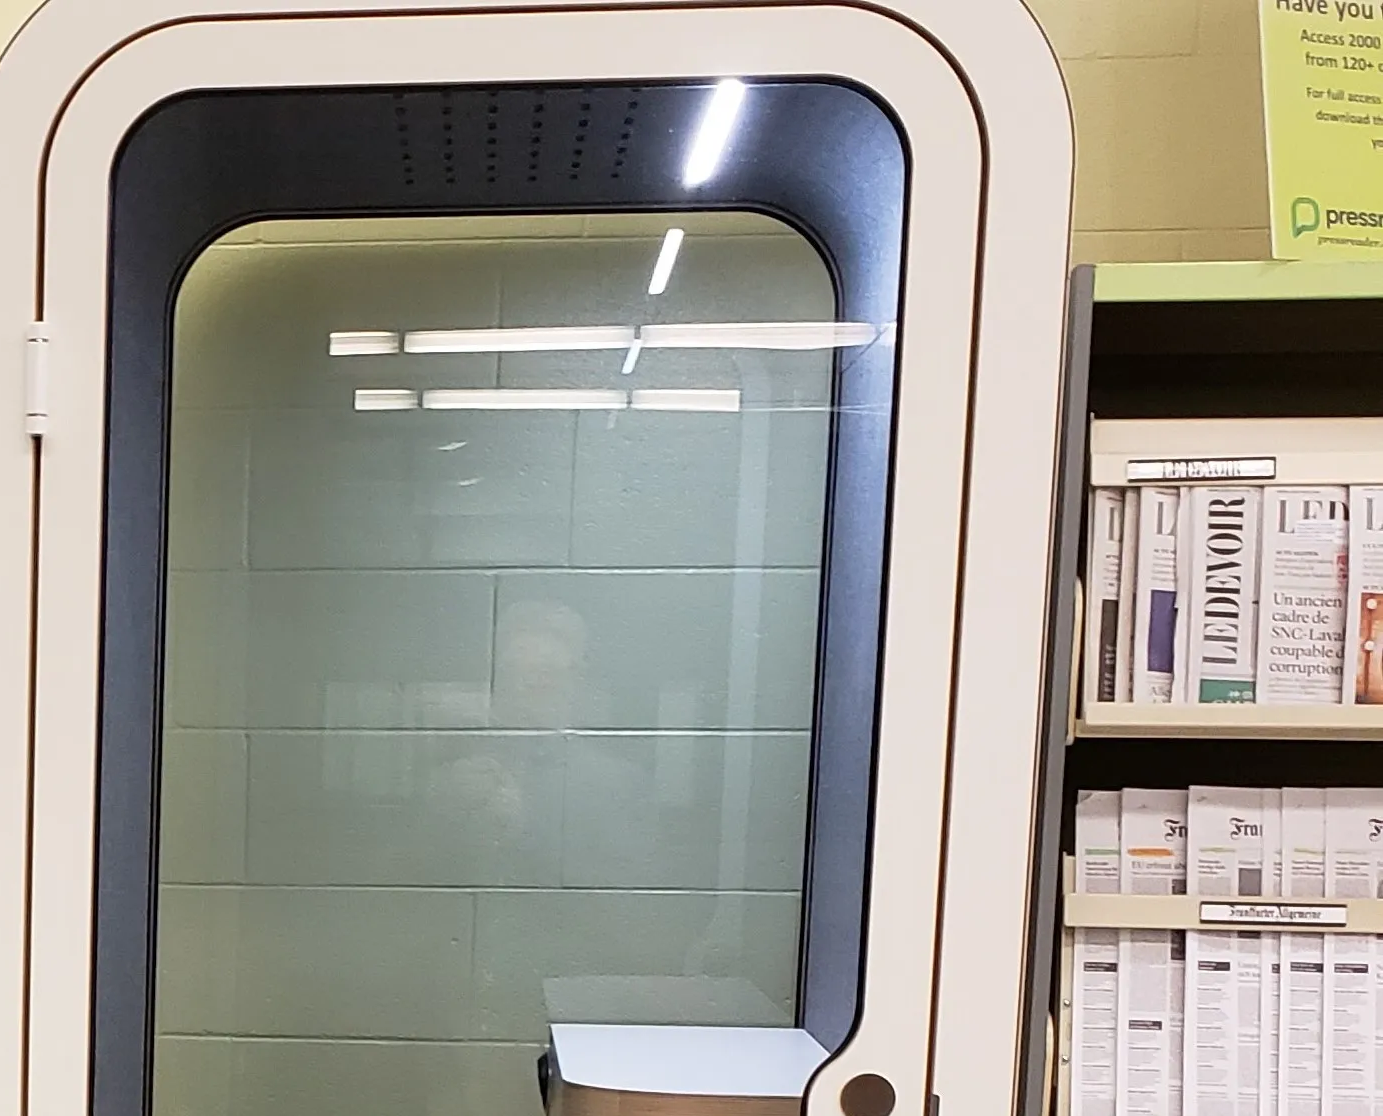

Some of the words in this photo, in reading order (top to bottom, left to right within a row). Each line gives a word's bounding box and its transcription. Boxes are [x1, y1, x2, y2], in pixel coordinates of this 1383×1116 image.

[1335, 1, 1374, 22] you
[1300, 29, 1345, 46] Access
[1348, 34, 1381, 49] 2000
[1305, 52, 1338, 69] from
[1342, 57, 1374, 71] 120+
[1316, 110, 1370, 125] download
[1273, 592, 1293, 606] Un
[1295, 594, 1342, 608] ancien
[1272, 609, 1309, 624] cadre
[1312, 610, 1330, 624] de
[1270, 644, 1334, 660] coupable
[1268, 662, 1343, 677] corruption
